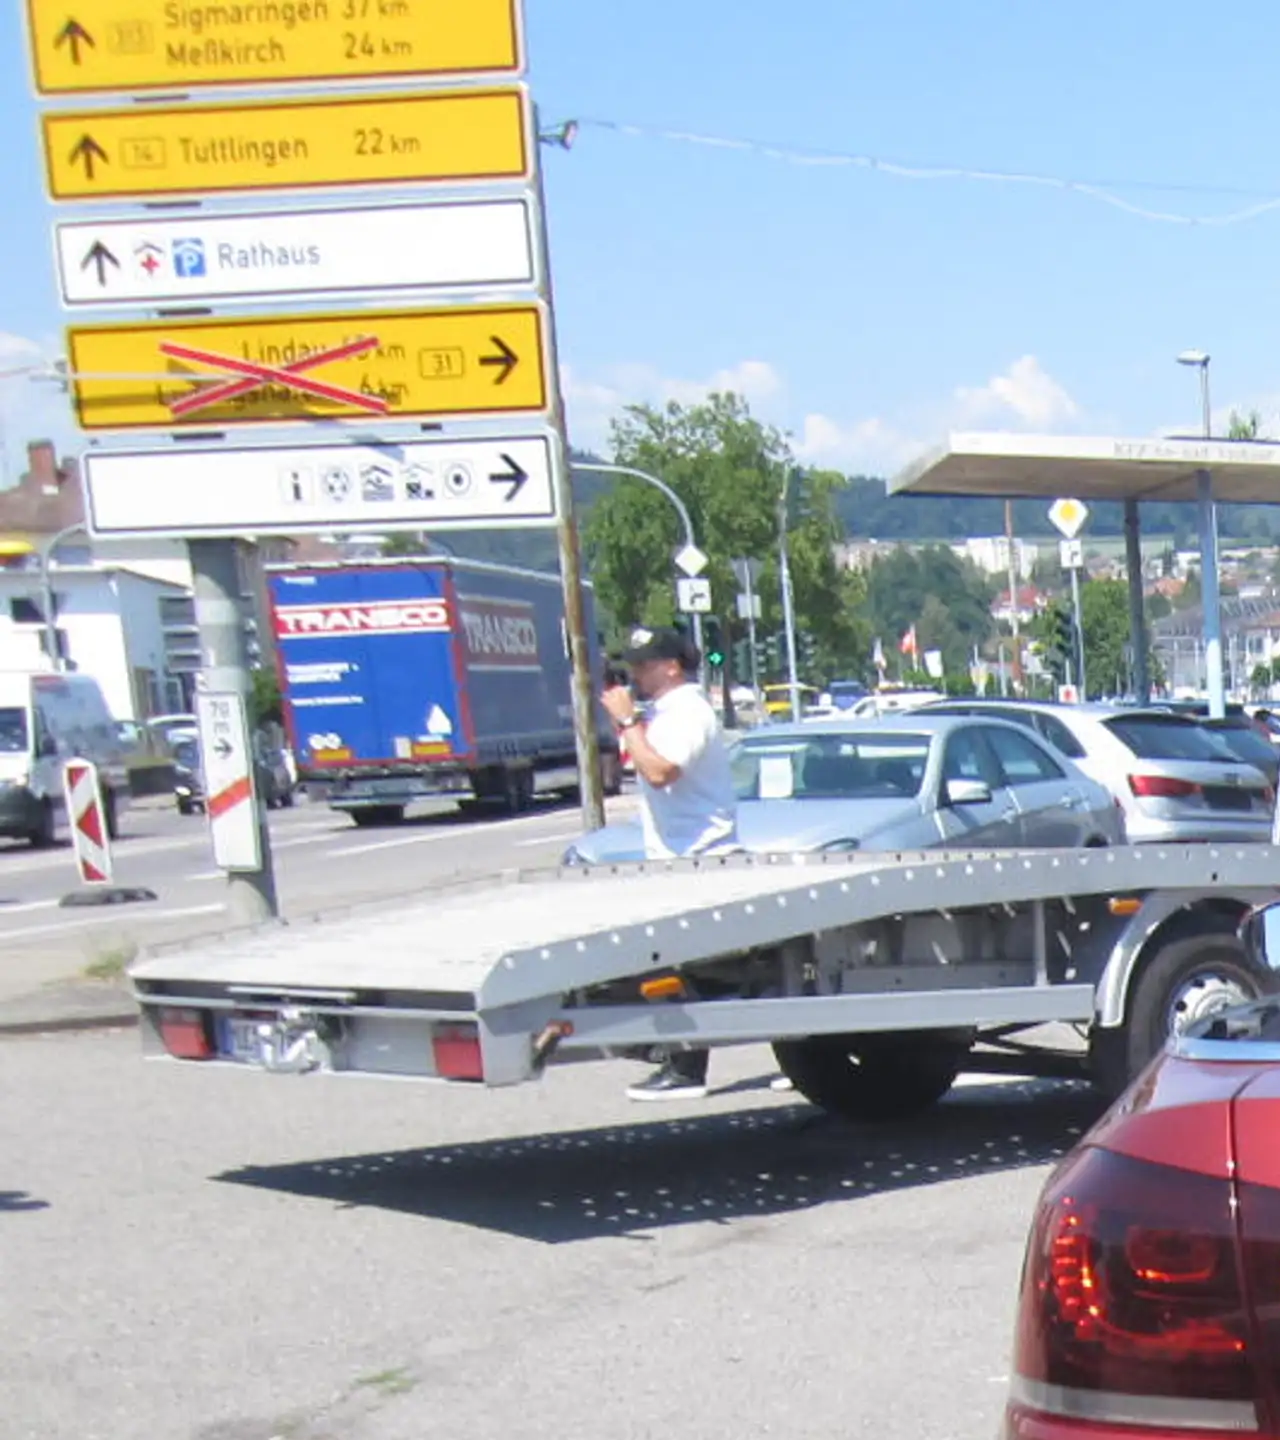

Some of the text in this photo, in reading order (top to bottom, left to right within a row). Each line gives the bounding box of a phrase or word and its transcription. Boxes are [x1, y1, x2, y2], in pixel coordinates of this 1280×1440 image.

[164, 0, 410, 35] Sigmaringen 37 km
[165, 32, 413, 66] Meßkirch 24 km
[179, 136, 309, 167] Tuttlingen
[354, 127, 385, 156] 22
[390, 133, 421, 154] km
[217, 242, 321, 269] Rathaus
[277, 604, 449, 633] TRANSCO
[460, 610, 539, 655] TRANSCO
